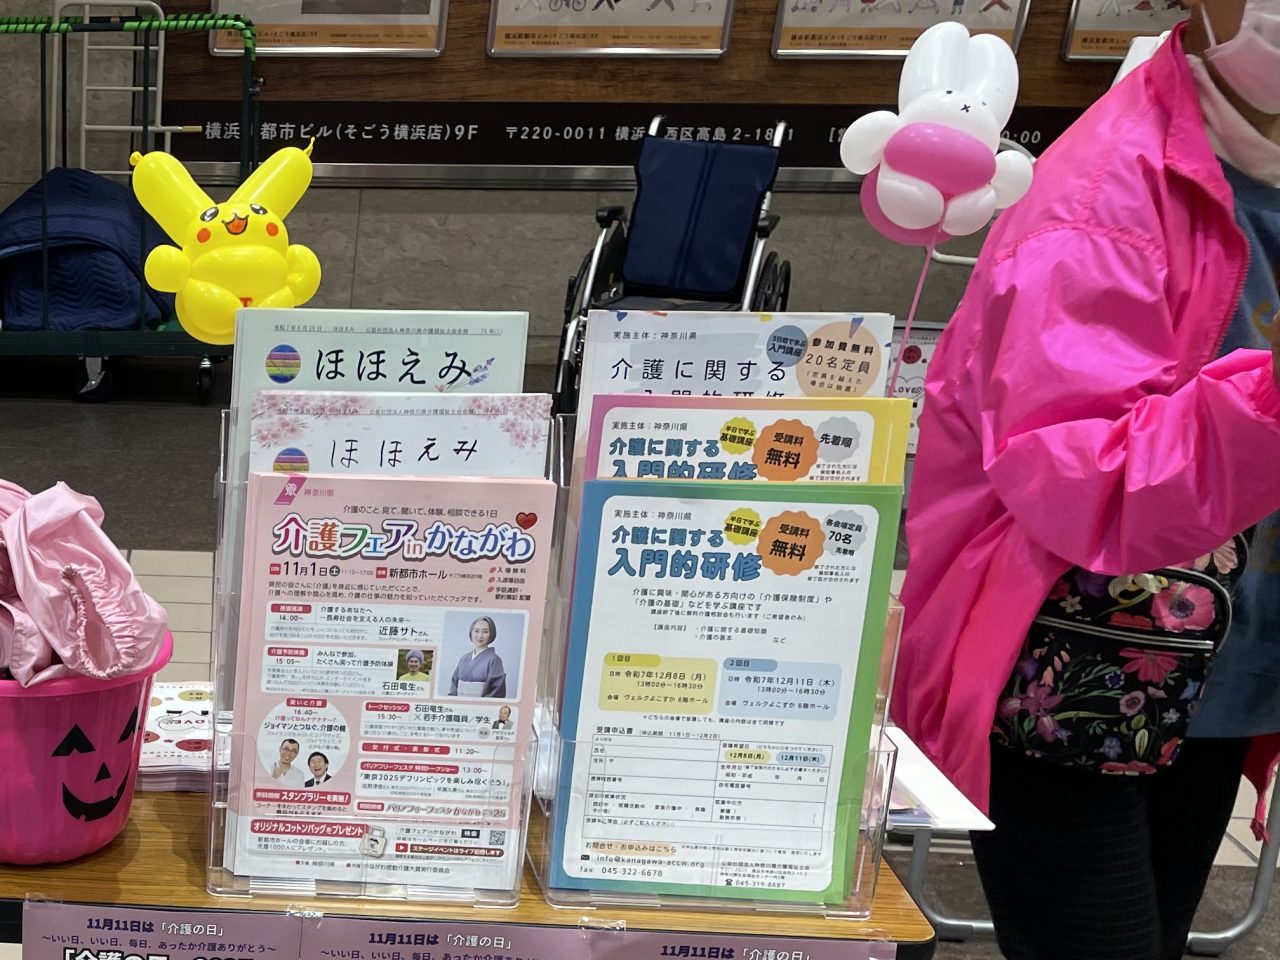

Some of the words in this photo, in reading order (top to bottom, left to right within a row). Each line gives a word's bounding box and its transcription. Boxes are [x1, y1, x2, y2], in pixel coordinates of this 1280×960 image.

[204, 120, 479, 141] 横浜都市ビル(そごう横浜店)9F
[614, 126, 727, 142] 横浜西区高島
[732, 127, 794, 142] 2-181
[768, 343, 803, 358] 入門講座
[812, 337, 874, 355] 参加費無料
[315, 347, 472, 385] ほほえみ
[610, 357, 787, 382] 介護に関する
[805, 353, 871, 375] 20名定員
[608, 436, 720, 458] 介護に関する
[720, 432, 754, 447] 基礎講座
[772, 432, 804, 447] 受講料
[819, 433, 854, 449] 先着順
[330, 438, 478, 469] ほほえみ
[764, 447, 801, 469] 無料
[609, 459, 758, 480] 入門的研修
[343, 504, 380, 514] 介護のこと
[724, 522, 759, 538] 基礎講座
[777, 523, 810, 539] 受講料
[826, 518, 863, 533] 各会場定員
[611, 525, 724, 548] 介護に関する
[828, 530, 853, 545] 70名
[769, 538, 807, 561] 無料
[607, 548, 763, 582] 入門的研修
[388, 567, 448, 580] 新都市ホール
[320, 606, 373, 614] 介護するあなたへ
[633, 598, 763, 612] 「介護の基礎」などを学ぶ講座です
[624, 670, 707, 682] 令和7年12月8日（月）
[744, 675, 836, 688] 令和7年12月11日（木）
[596, 726, 634, 735] 受講申込書
[253, 821, 364, 836] オリジナルコットンバッグをプレゼント
[579, 866, 593, 875] fax
